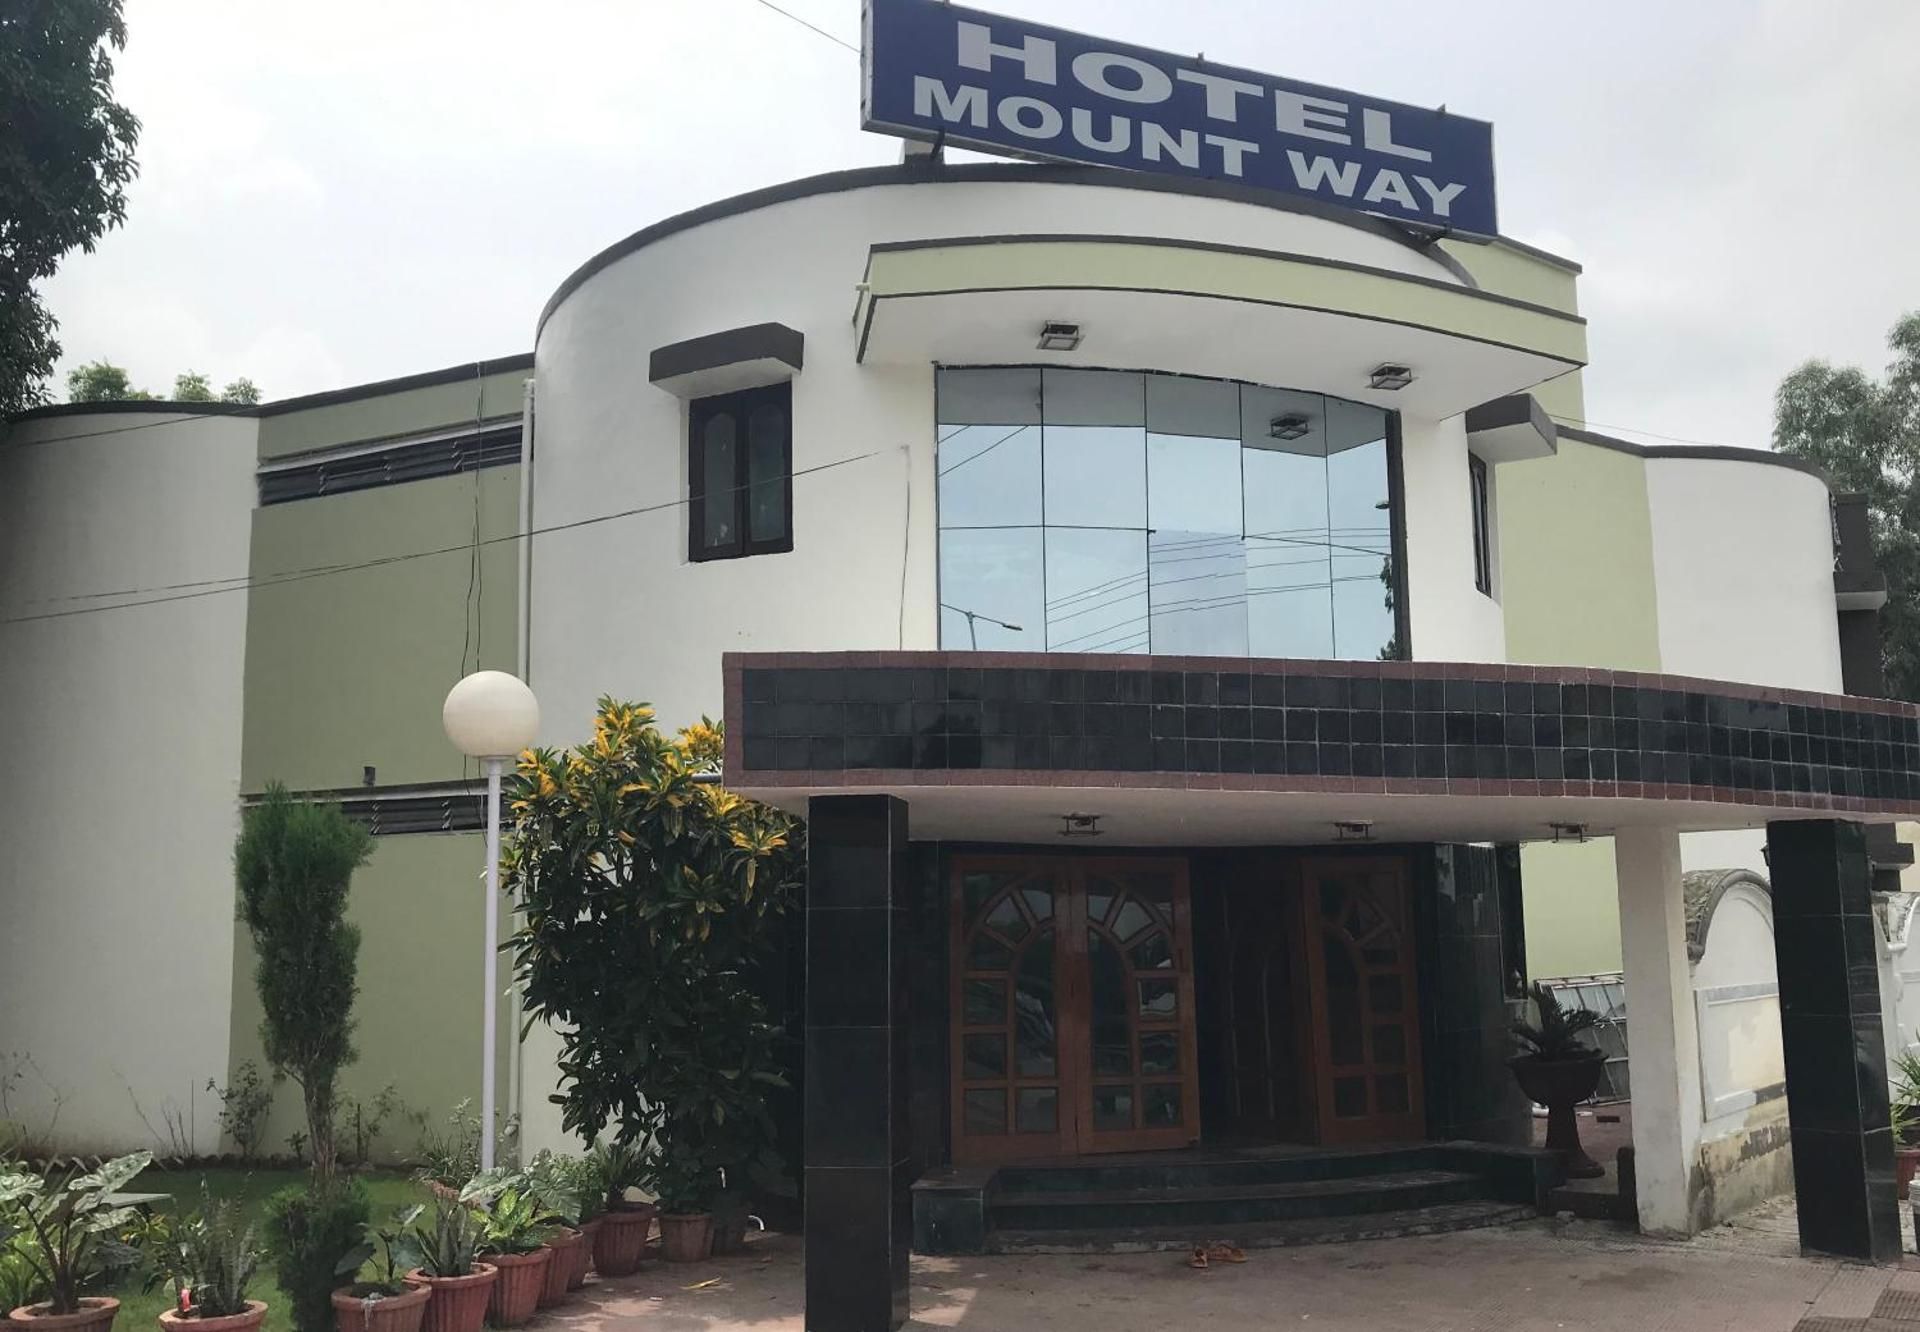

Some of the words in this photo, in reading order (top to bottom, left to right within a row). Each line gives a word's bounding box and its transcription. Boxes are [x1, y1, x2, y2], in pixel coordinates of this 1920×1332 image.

[913, 75, 1260, 177] MOUNT
[1286, 150, 1467, 216] WAY
[957, 20, 1433, 163] HOTEL
